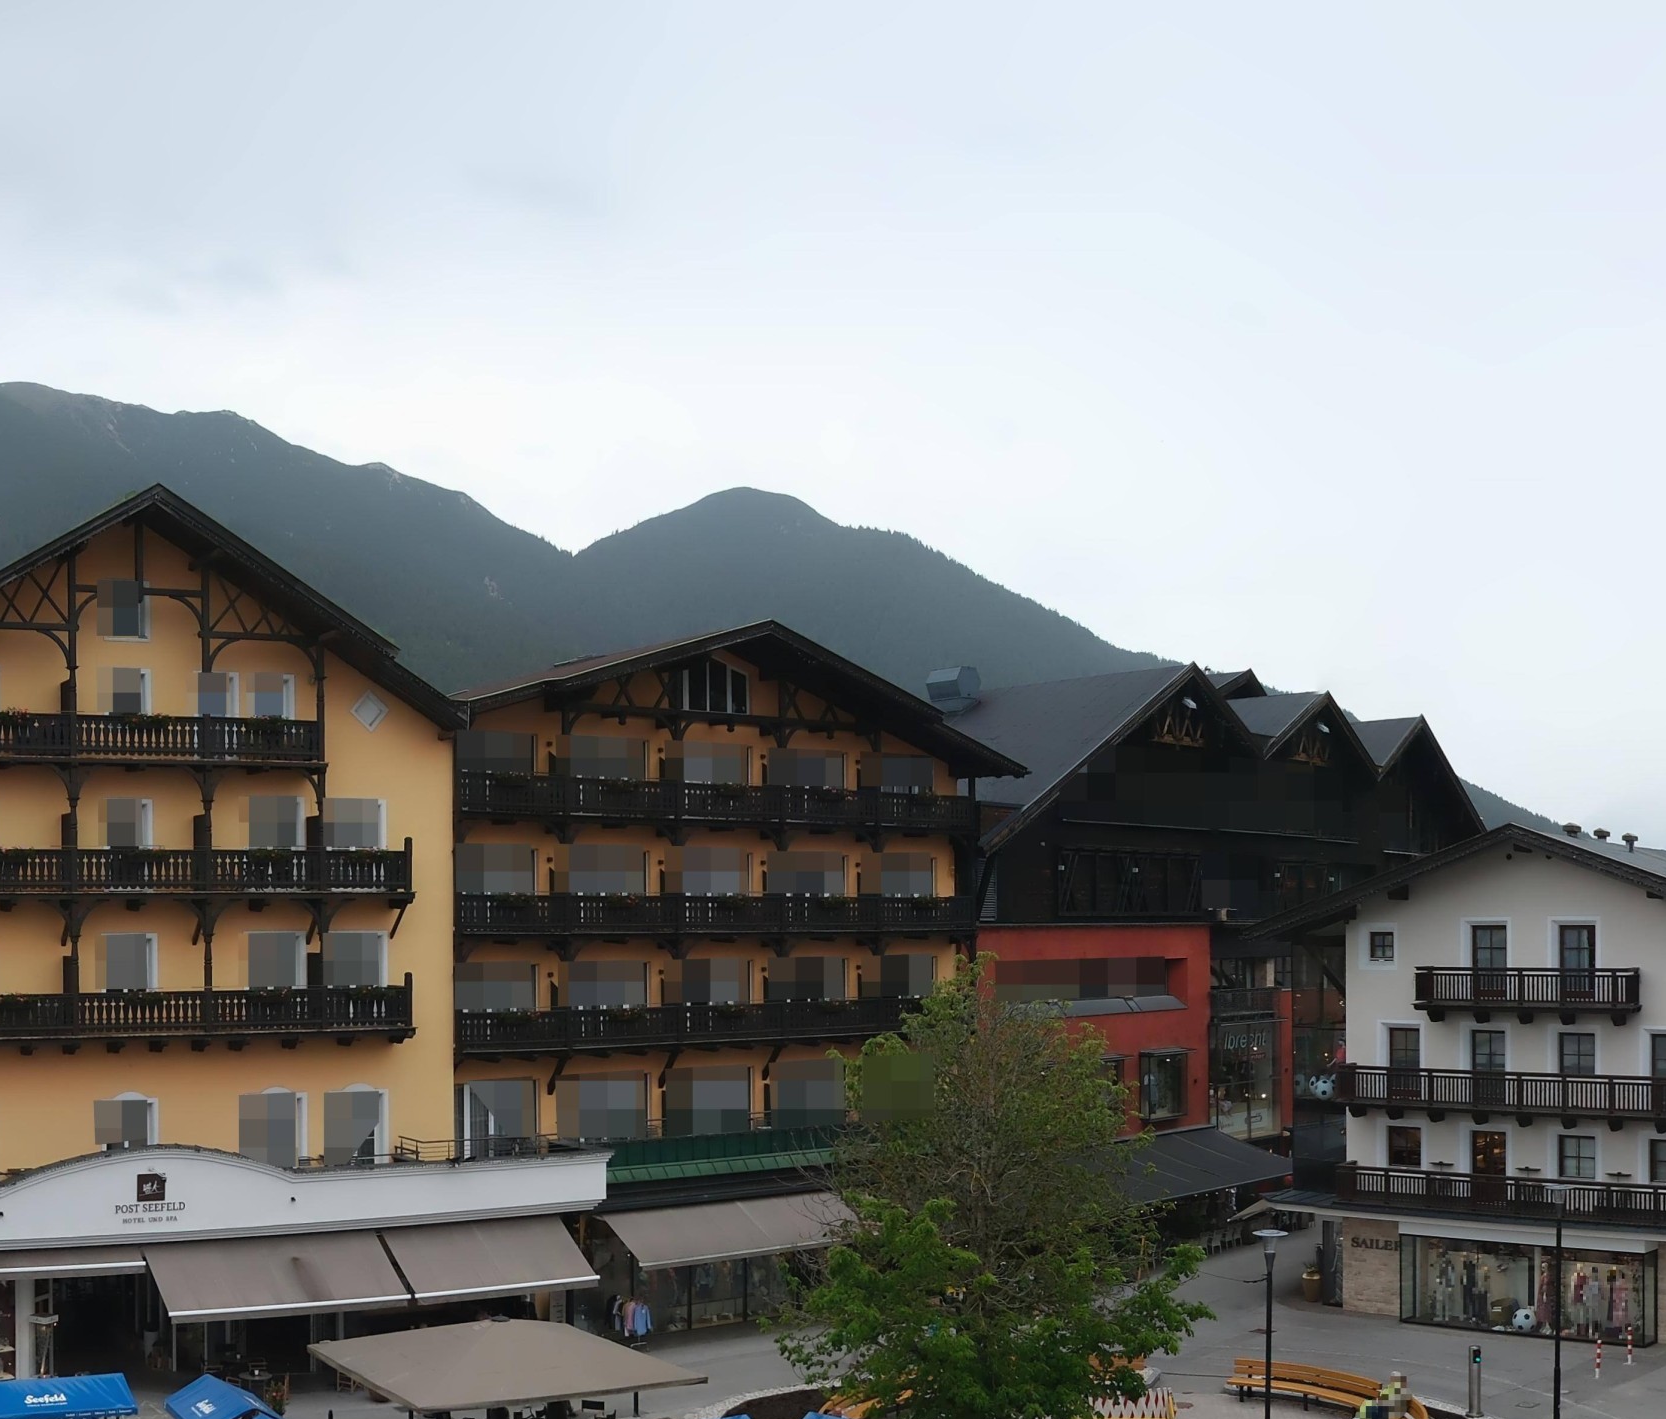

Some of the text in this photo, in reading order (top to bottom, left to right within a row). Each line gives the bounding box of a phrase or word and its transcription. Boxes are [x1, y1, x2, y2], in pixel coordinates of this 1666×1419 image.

[115, 1201, 186, 1214] POST SEEFELD
[24, 1393, 67, 1404] Seefeld
